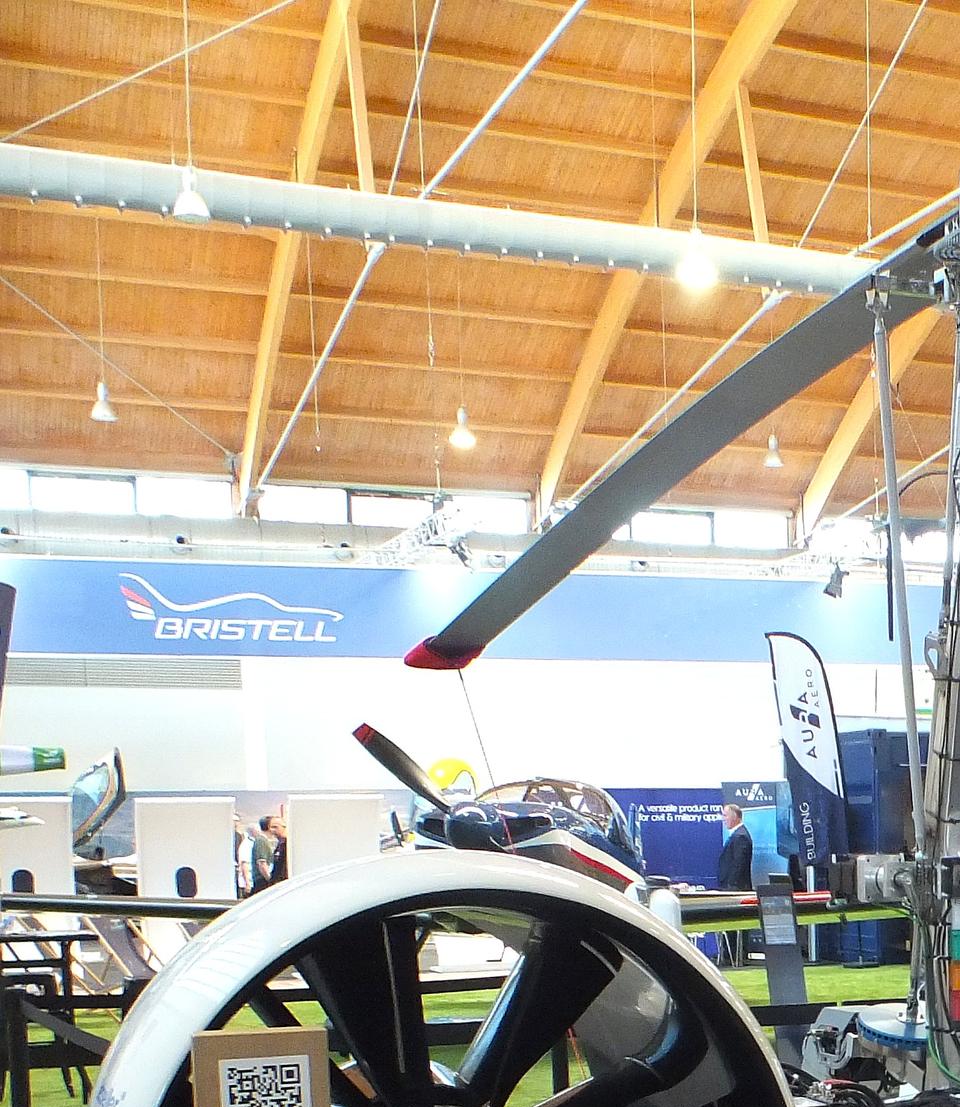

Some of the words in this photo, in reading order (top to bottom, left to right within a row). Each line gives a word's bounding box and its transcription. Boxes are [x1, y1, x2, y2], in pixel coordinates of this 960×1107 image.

[155, 618, 337, 643] BRISTELL
[804, 668, 821, 708] AERO
[638, 804, 645, 812] A
[679, 804, 708, 814] product
[675, 813, 702, 822] military
[798, 802, 817, 861] BUILDING
